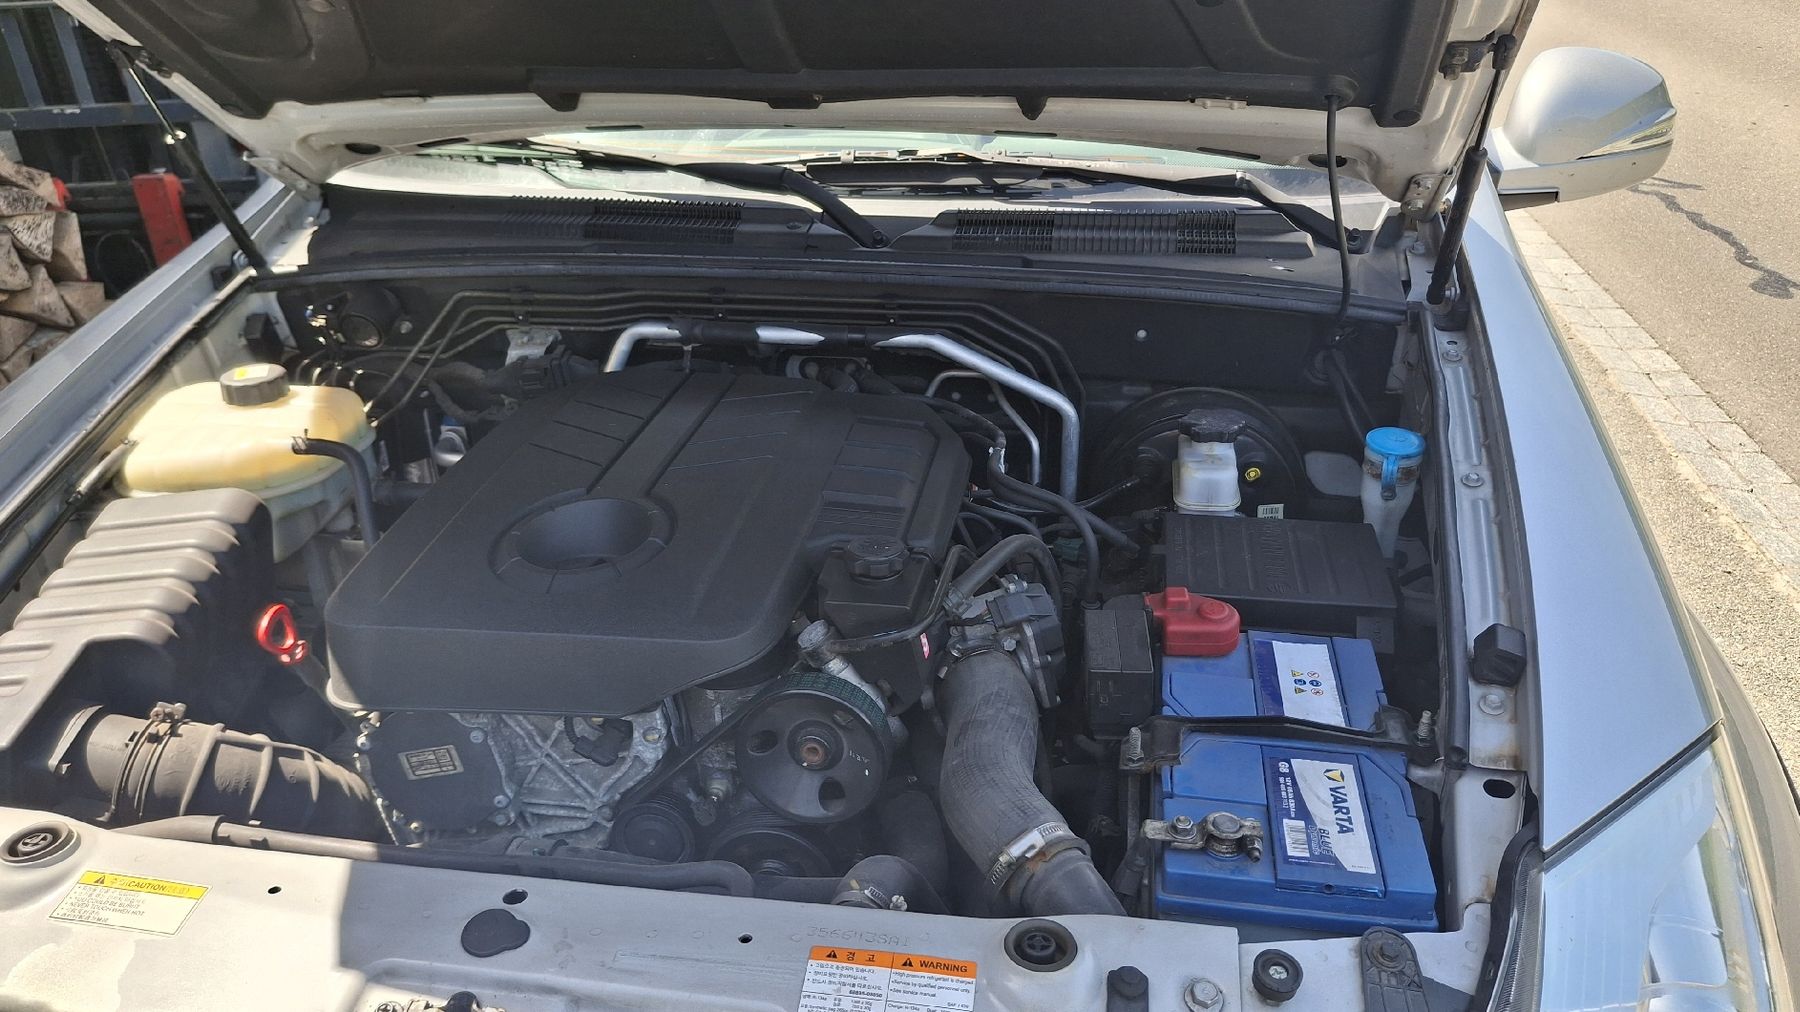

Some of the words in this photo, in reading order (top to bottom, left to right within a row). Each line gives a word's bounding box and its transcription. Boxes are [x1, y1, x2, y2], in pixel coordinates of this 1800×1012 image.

[1279, 761, 1290, 773] G8
[1329, 785, 1354, 834] VARTA
[1318, 828, 1335, 857] BLUE
[919, 959, 968, 973] WARNING
